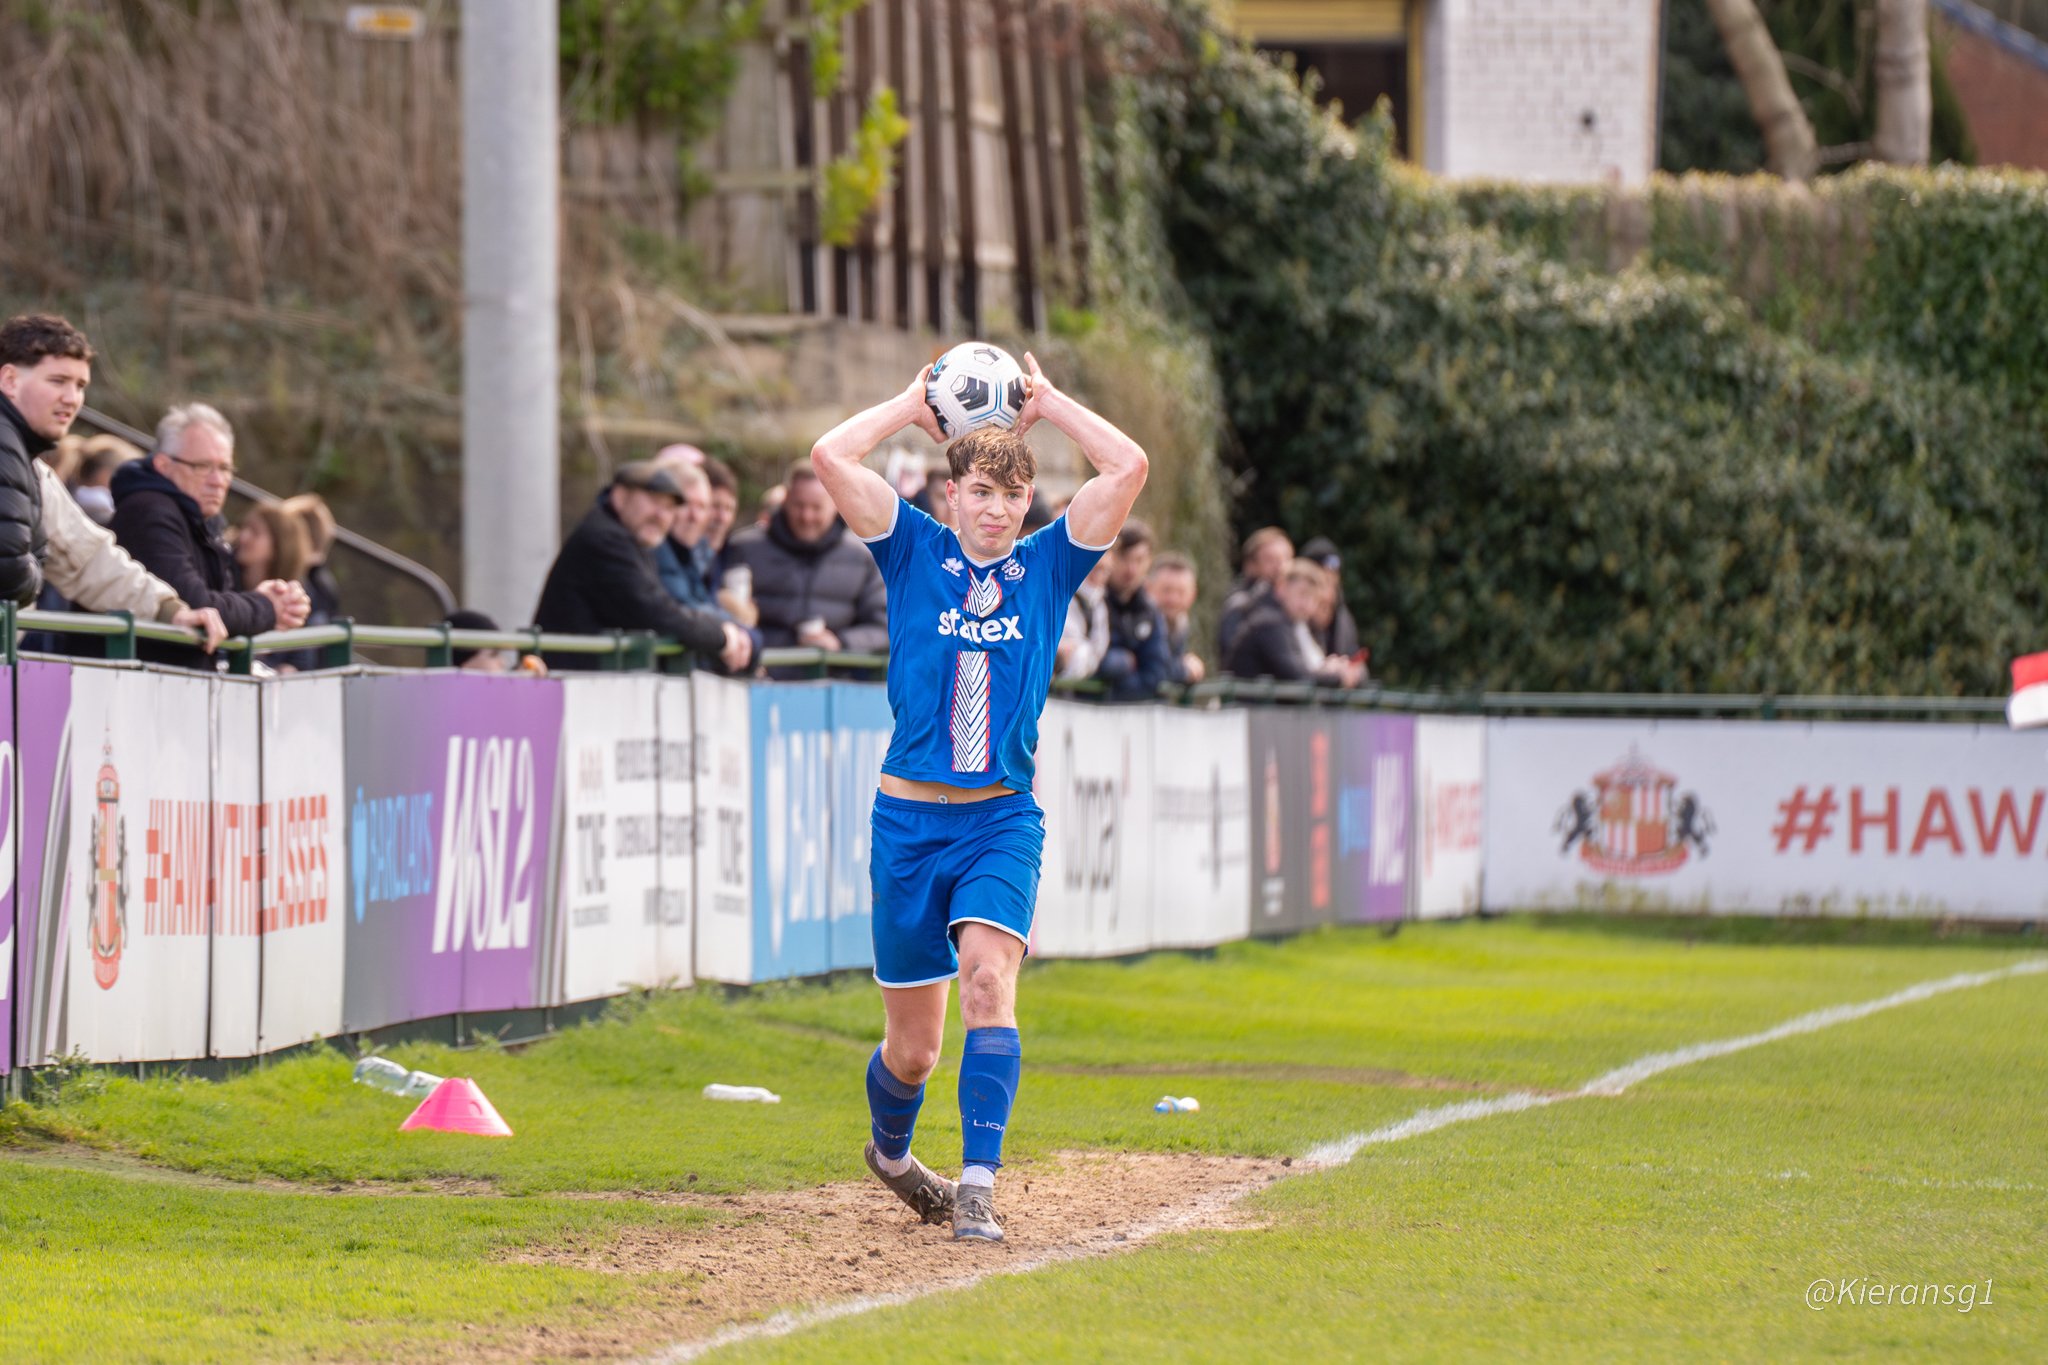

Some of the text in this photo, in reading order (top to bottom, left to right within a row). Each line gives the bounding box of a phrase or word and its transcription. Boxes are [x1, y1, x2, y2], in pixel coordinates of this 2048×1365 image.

[938, 608, 1023, 644] statex
[432, 735, 536, 954] WSL2
[1770, 784, 2048, 857] #HAW
